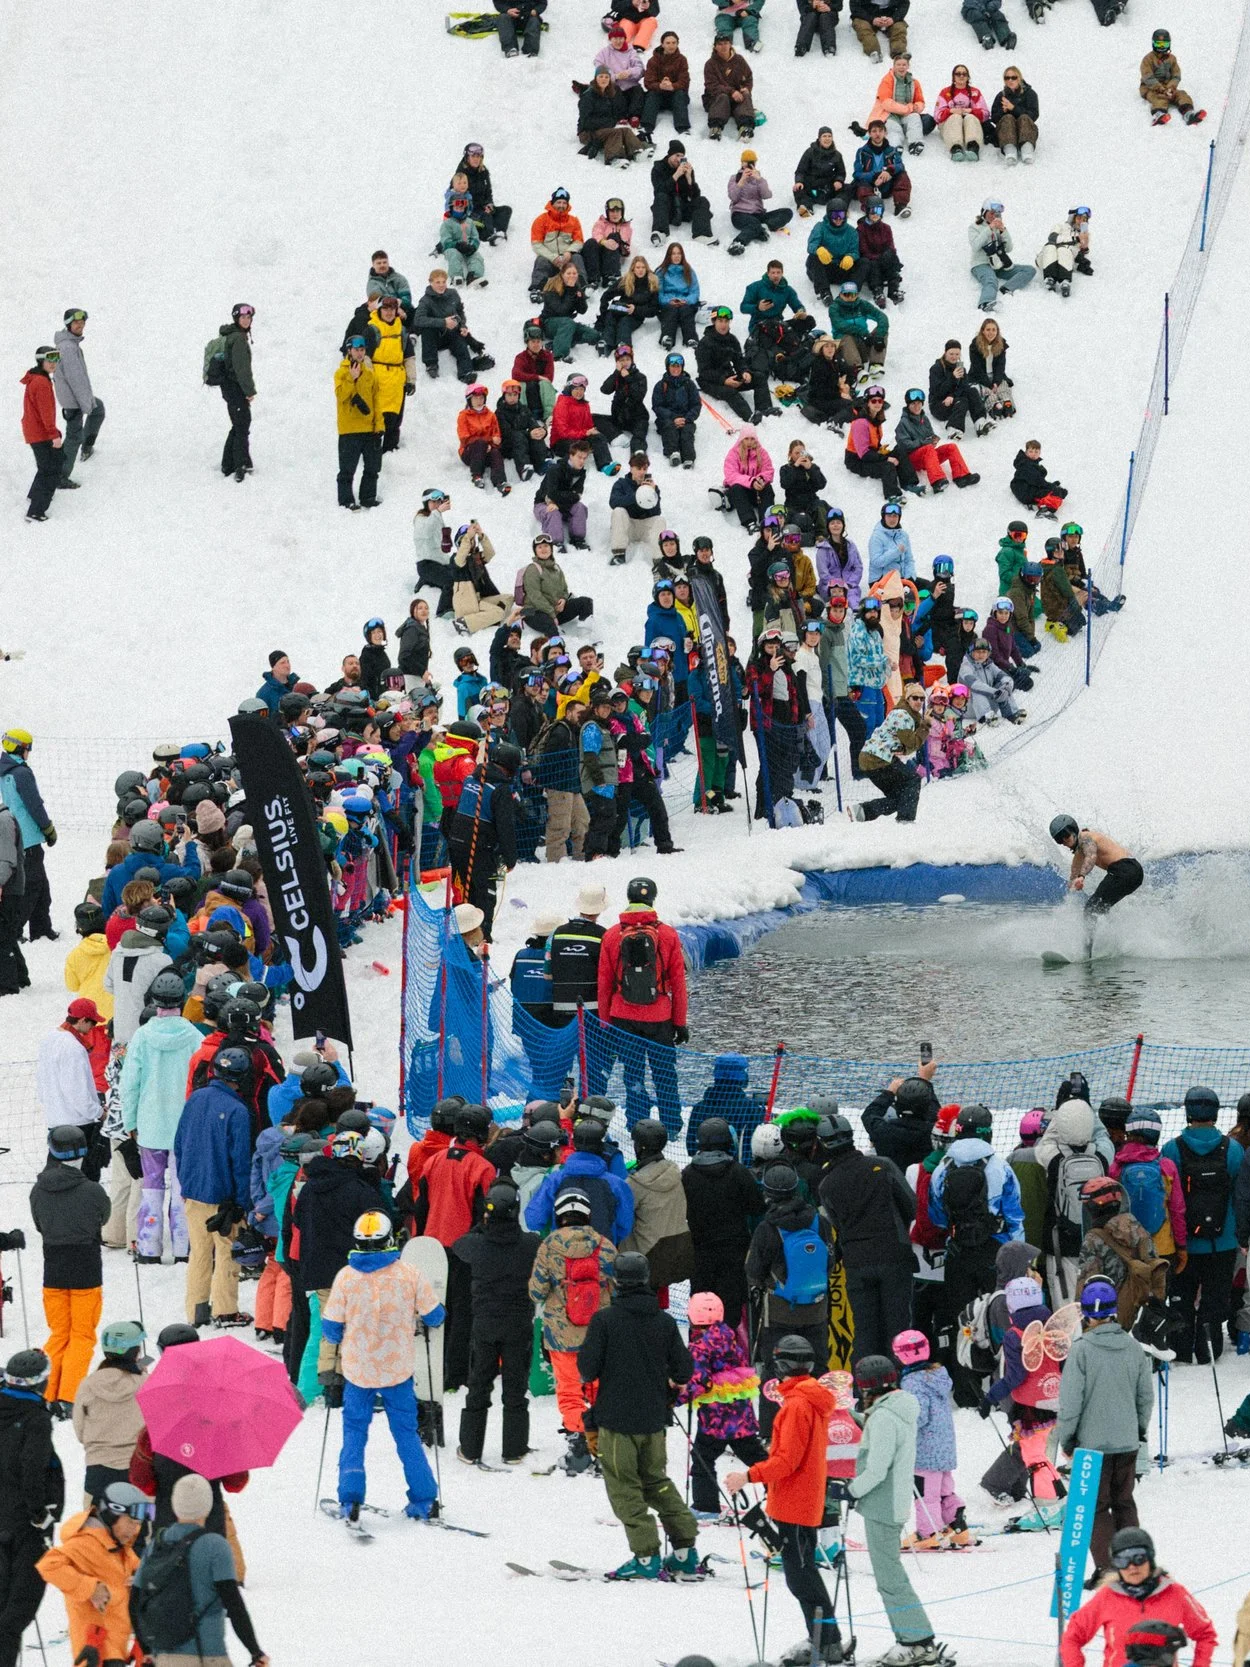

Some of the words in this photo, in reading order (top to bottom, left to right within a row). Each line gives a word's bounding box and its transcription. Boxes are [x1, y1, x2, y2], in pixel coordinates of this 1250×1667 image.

[281, 797, 291, 816] FIT
[287, 817, 298, 845] LIVE
[264, 799, 309, 931] CELSIUS
[1079, 1454, 1093, 1496] ADULT
[1070, 1504, 1086, 1548] GROUP
[1061, 1556, 1077, 1618] LESSONS
